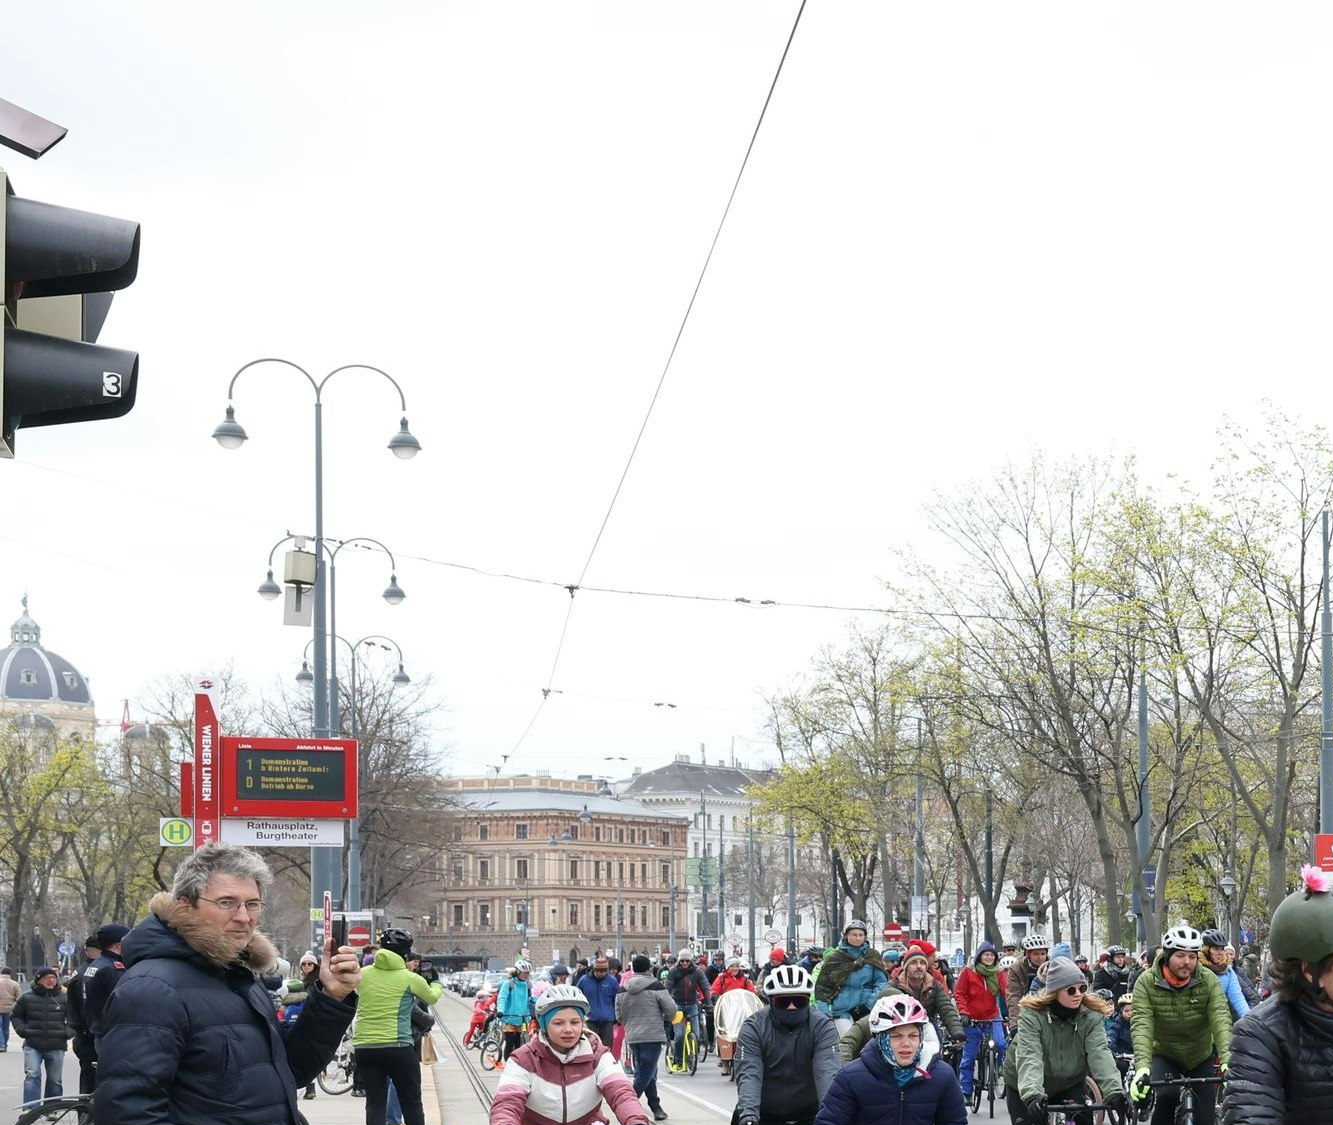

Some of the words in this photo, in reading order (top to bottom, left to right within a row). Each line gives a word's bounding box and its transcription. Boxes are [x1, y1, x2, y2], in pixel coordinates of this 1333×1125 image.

[106, 374, 121, 396] 3
[201, 724, 212, 766] WIENER
[201, 767, 212, 802] LINIEN
[246, 821, 318, 832] Rathausplatz,
[256, 831, 318, 841] Burgtheater
